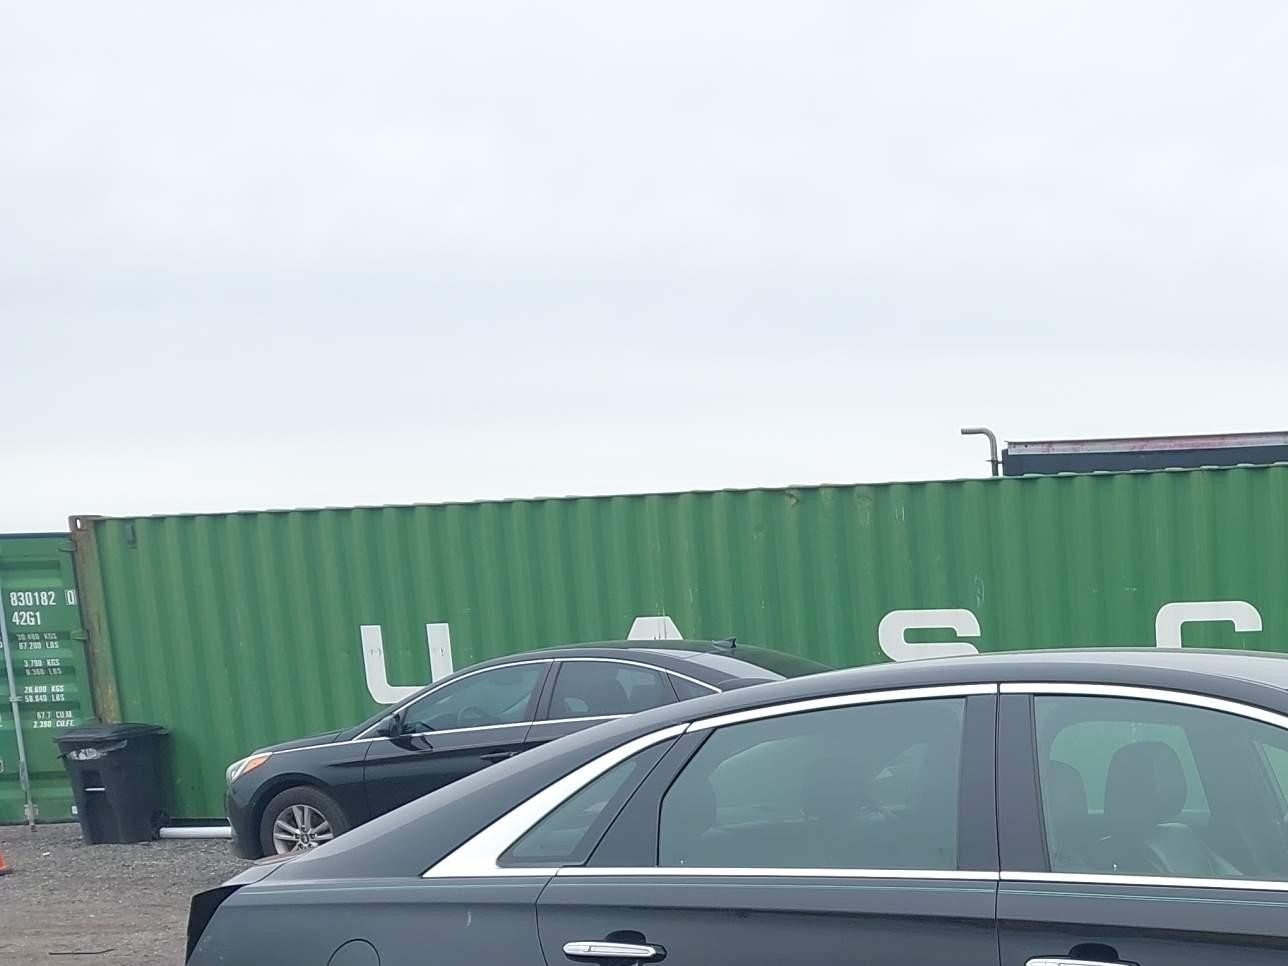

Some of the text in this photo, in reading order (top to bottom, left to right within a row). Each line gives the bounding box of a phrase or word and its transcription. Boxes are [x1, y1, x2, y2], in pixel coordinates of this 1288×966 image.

[10, 591, 56, 606] 830182
[12, 611, 41, 625] 42G1
[45, 641, 59, 649] LBS
[51, 685, 64, 693] KGS
[51, 693, 65, 702] LBS
